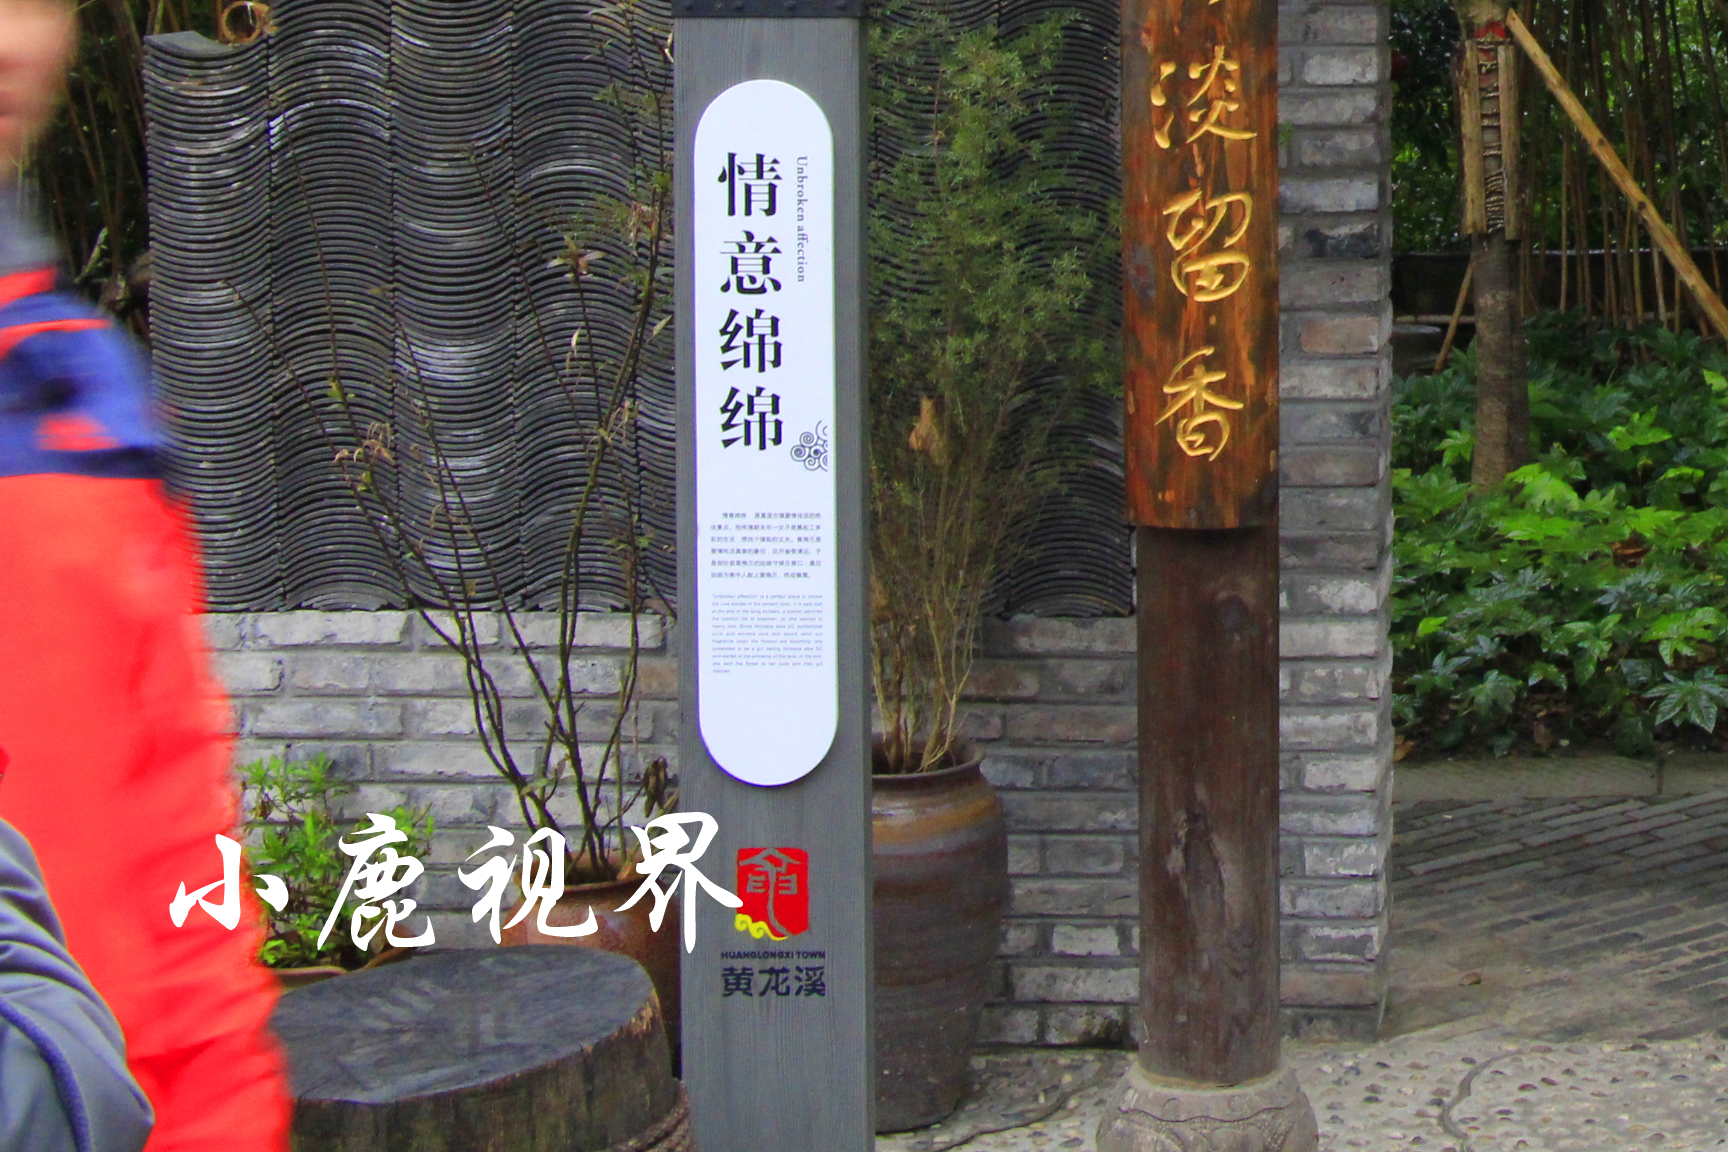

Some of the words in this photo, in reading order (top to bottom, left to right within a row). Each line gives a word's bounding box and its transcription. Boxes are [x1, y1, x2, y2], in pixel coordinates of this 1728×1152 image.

[796, 156, 809, 222] Unbroken
[796, 224, 809, 283] affection
[717, 152, 783, 451] 情意绵绵
[721, 951, 794, 960] HUANGLONGXI
[796, 951, 826, 960] TOWN
[721, 965, 826, 998] 黄龙溪
